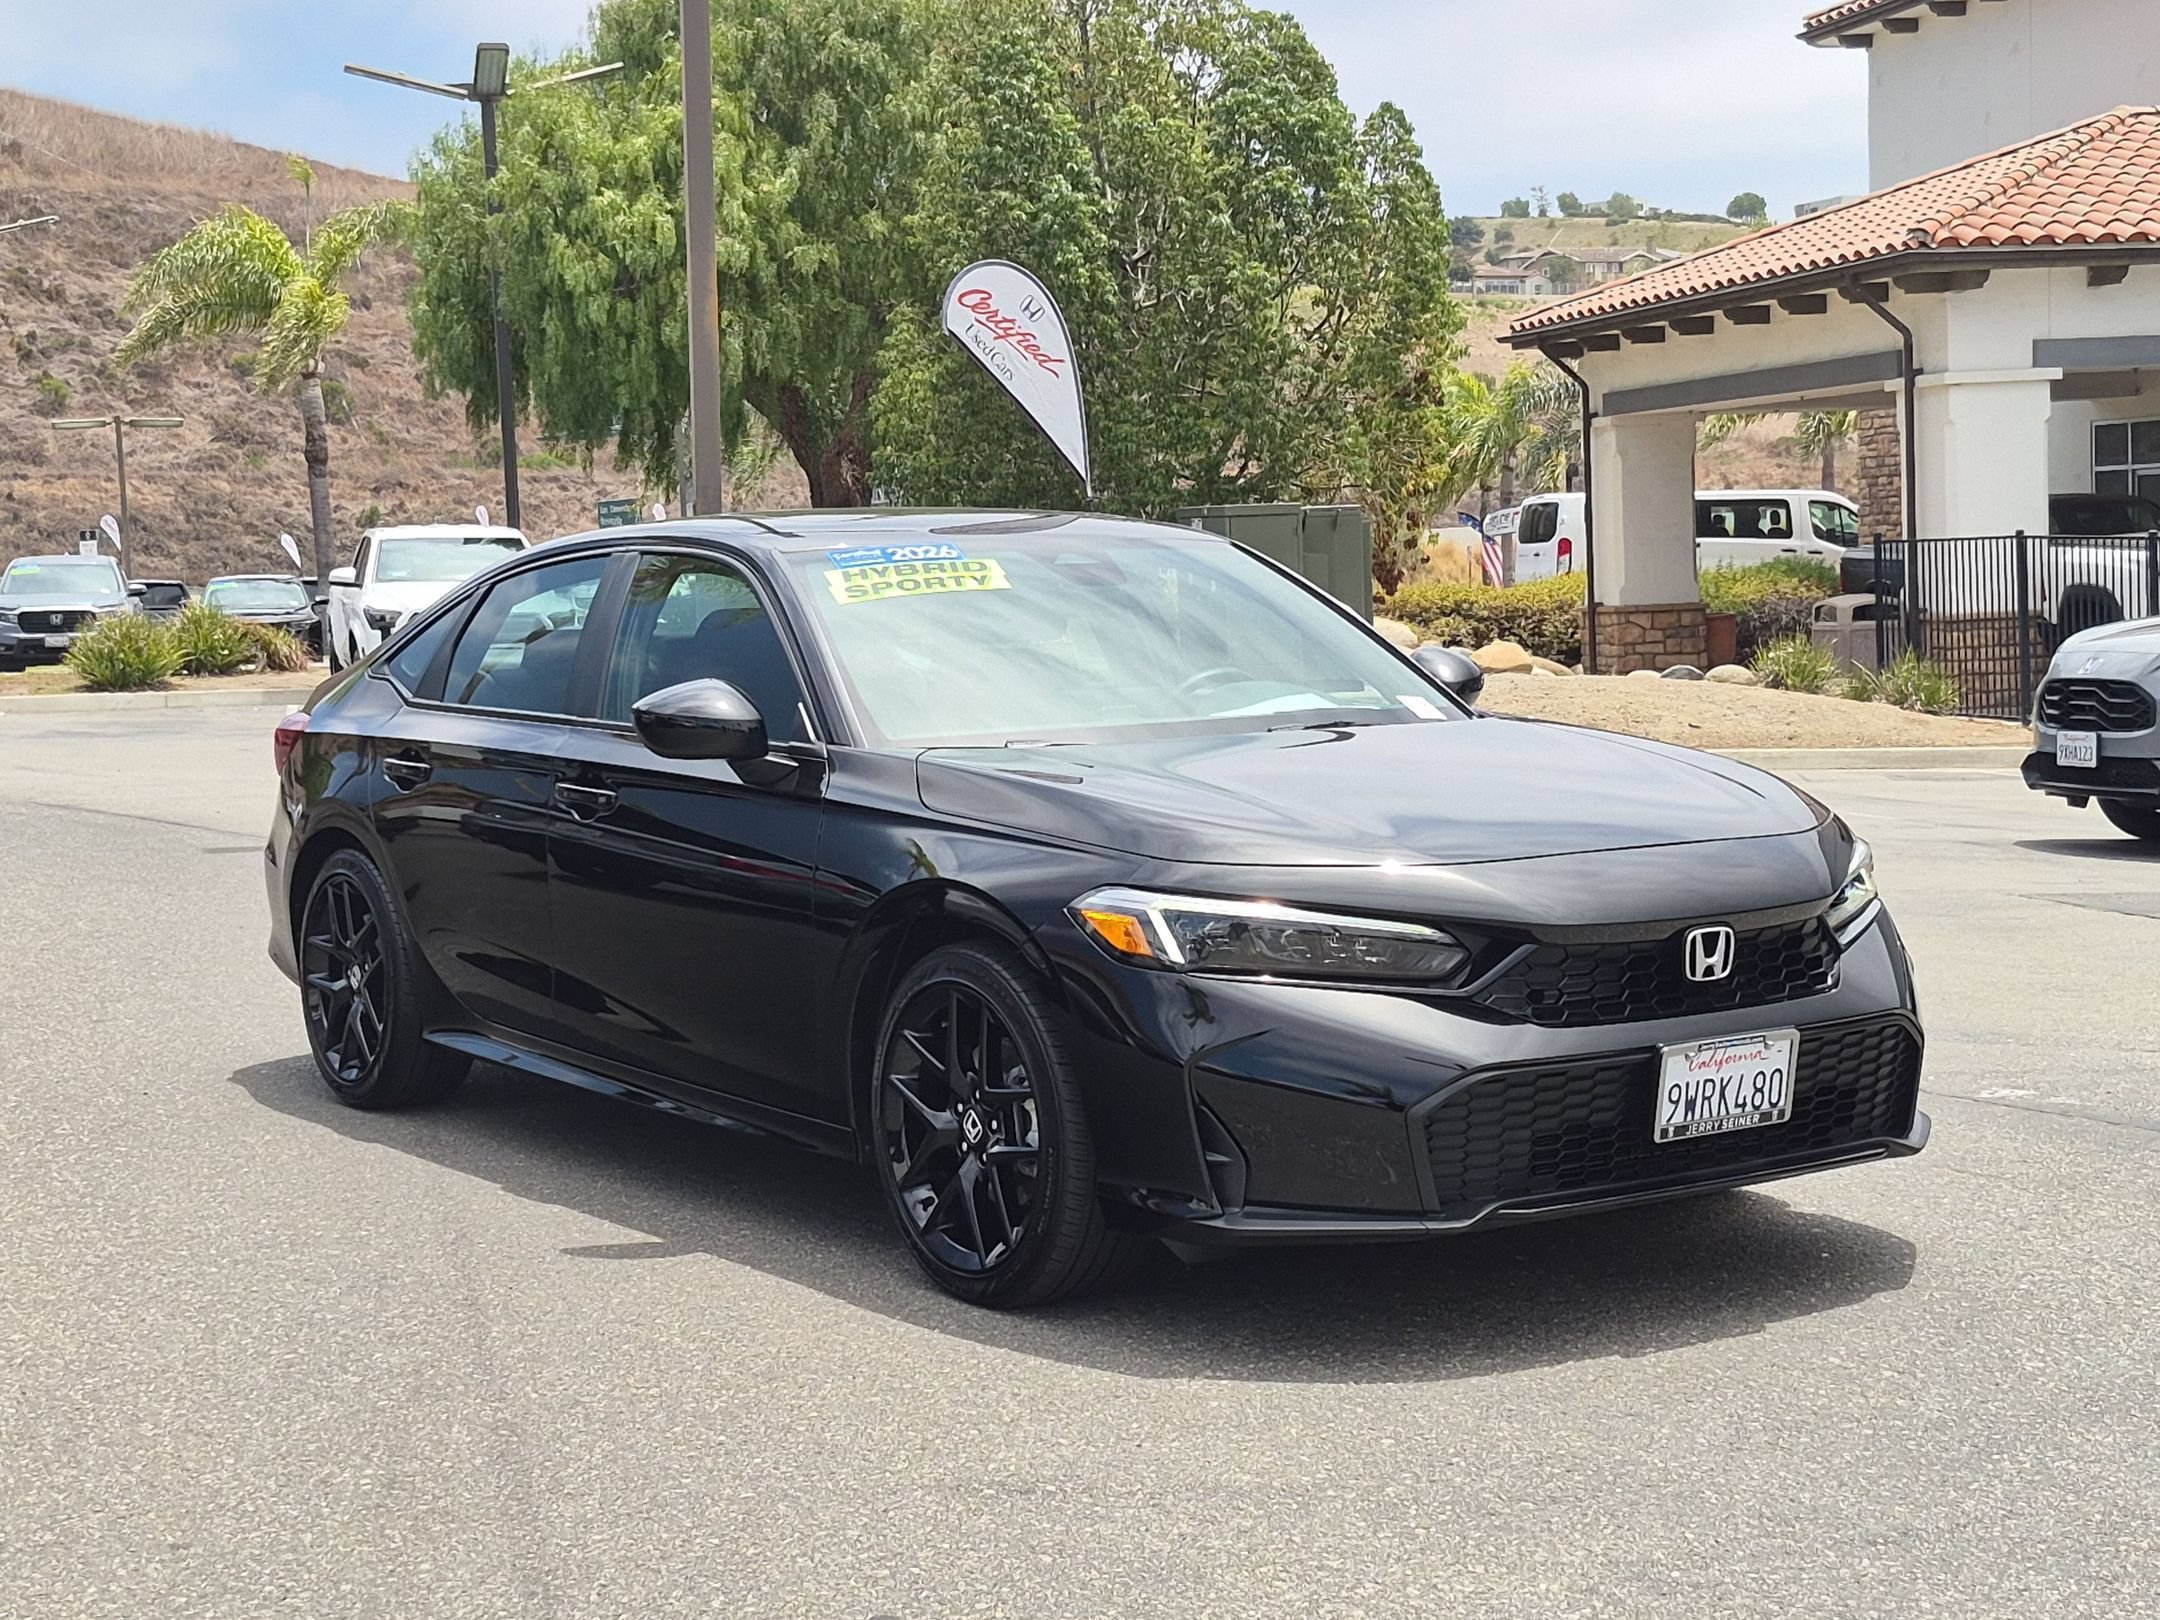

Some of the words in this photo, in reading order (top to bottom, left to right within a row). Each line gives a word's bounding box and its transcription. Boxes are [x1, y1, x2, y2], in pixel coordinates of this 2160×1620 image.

[958, 289, 1065, 379] Certified
[965, 323, 995, 357] Used
[990, 351, 1015, 381] Cars
[887, 545, 958, 561] 2026
[841, 561, 988, 583] HYBRID
[844, 575, 988, 598] SPORTY
[1688, 1048, 1769, 1074] California
[1666, 1068, 1784, 1124] 9WRK480
[1686, 1120, 1719, 1135] JERRY
[1722, 1114, 1760, 1129] SEINER
